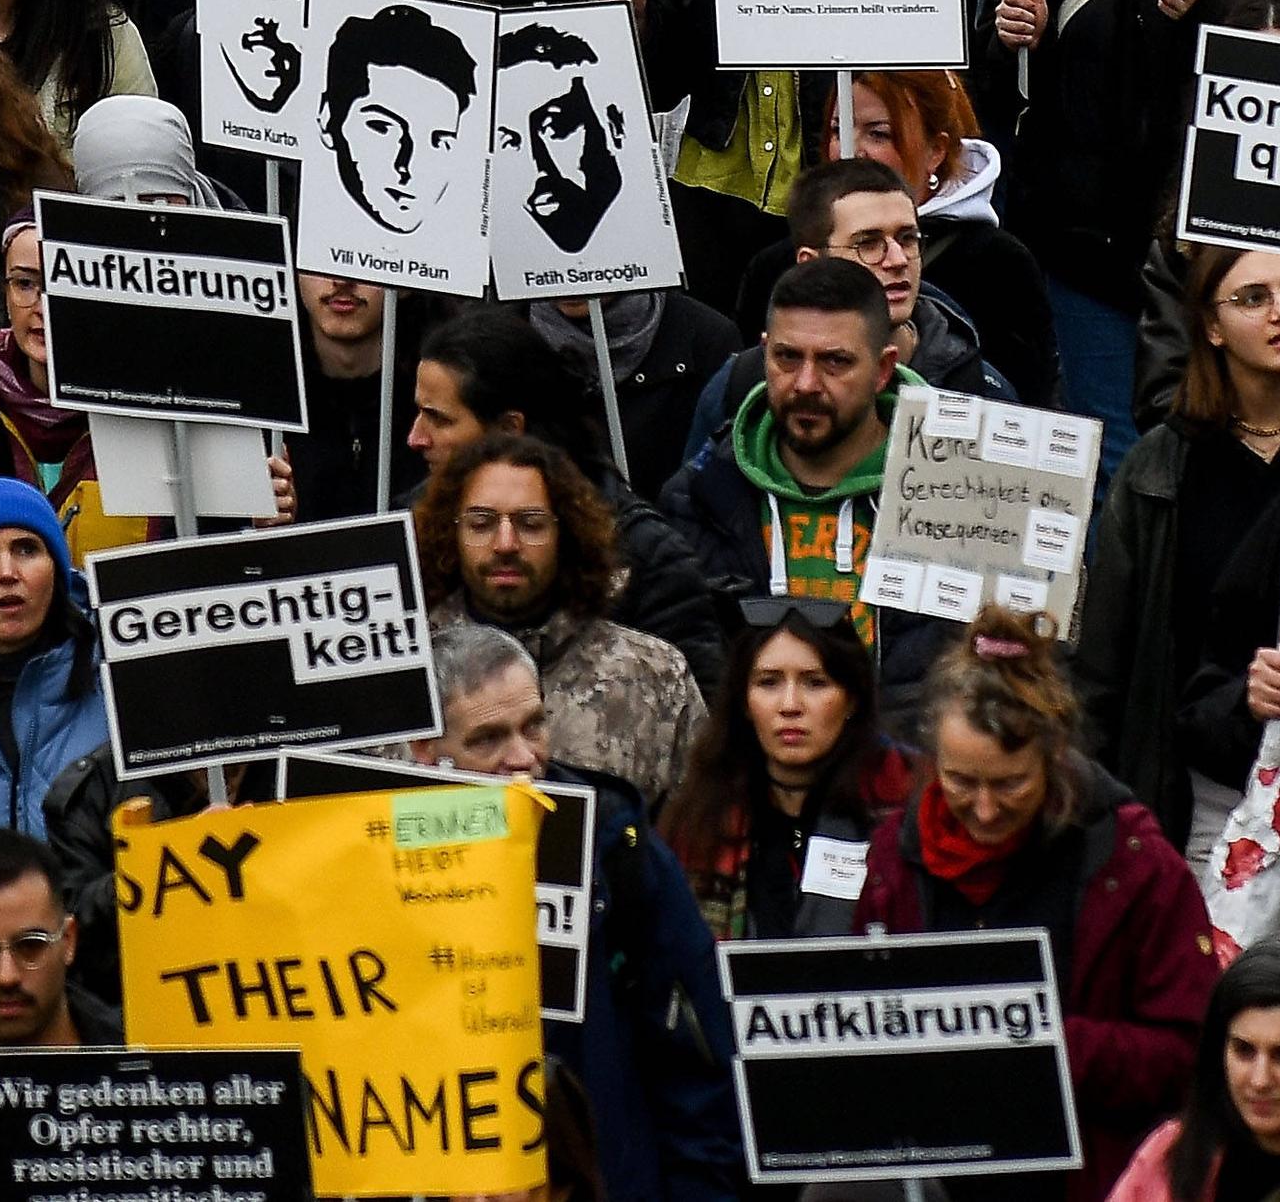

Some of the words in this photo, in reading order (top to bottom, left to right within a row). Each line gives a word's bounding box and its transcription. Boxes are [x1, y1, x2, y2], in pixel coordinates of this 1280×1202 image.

[222, 120, 261, 141] Hamza
[50, 248, 289, 311] Aufklärung!
[330, 247, 355, 265] Vili
[358, 251, 405, 276] Viorel
[407, 257, 450, 281] Păun
[524, 268, 563, 287] Fatih
[566, 263, 648, 286] Saraçoğlu
[109, 580, 394, 646] Gerechtig-
[304, 616, 420, 671] keit!
[117, 831, 261, 917] SAY
[160, 950, 398, 1025] THEIR
[746, 992, 1052, 1043] Aufklärung!
[57, 1074, 206, 1115] gedenken
[213, 1073, 286, 1106] aller
[306, 1060, 545, 1157] NAMES
[28, 1112, 124, 1152] Opfer
[130, 1111, 254, 1147] rechter,
[12, 1149, 205, 1183] rassistischer
[211, 1147, 275, 1179] und
